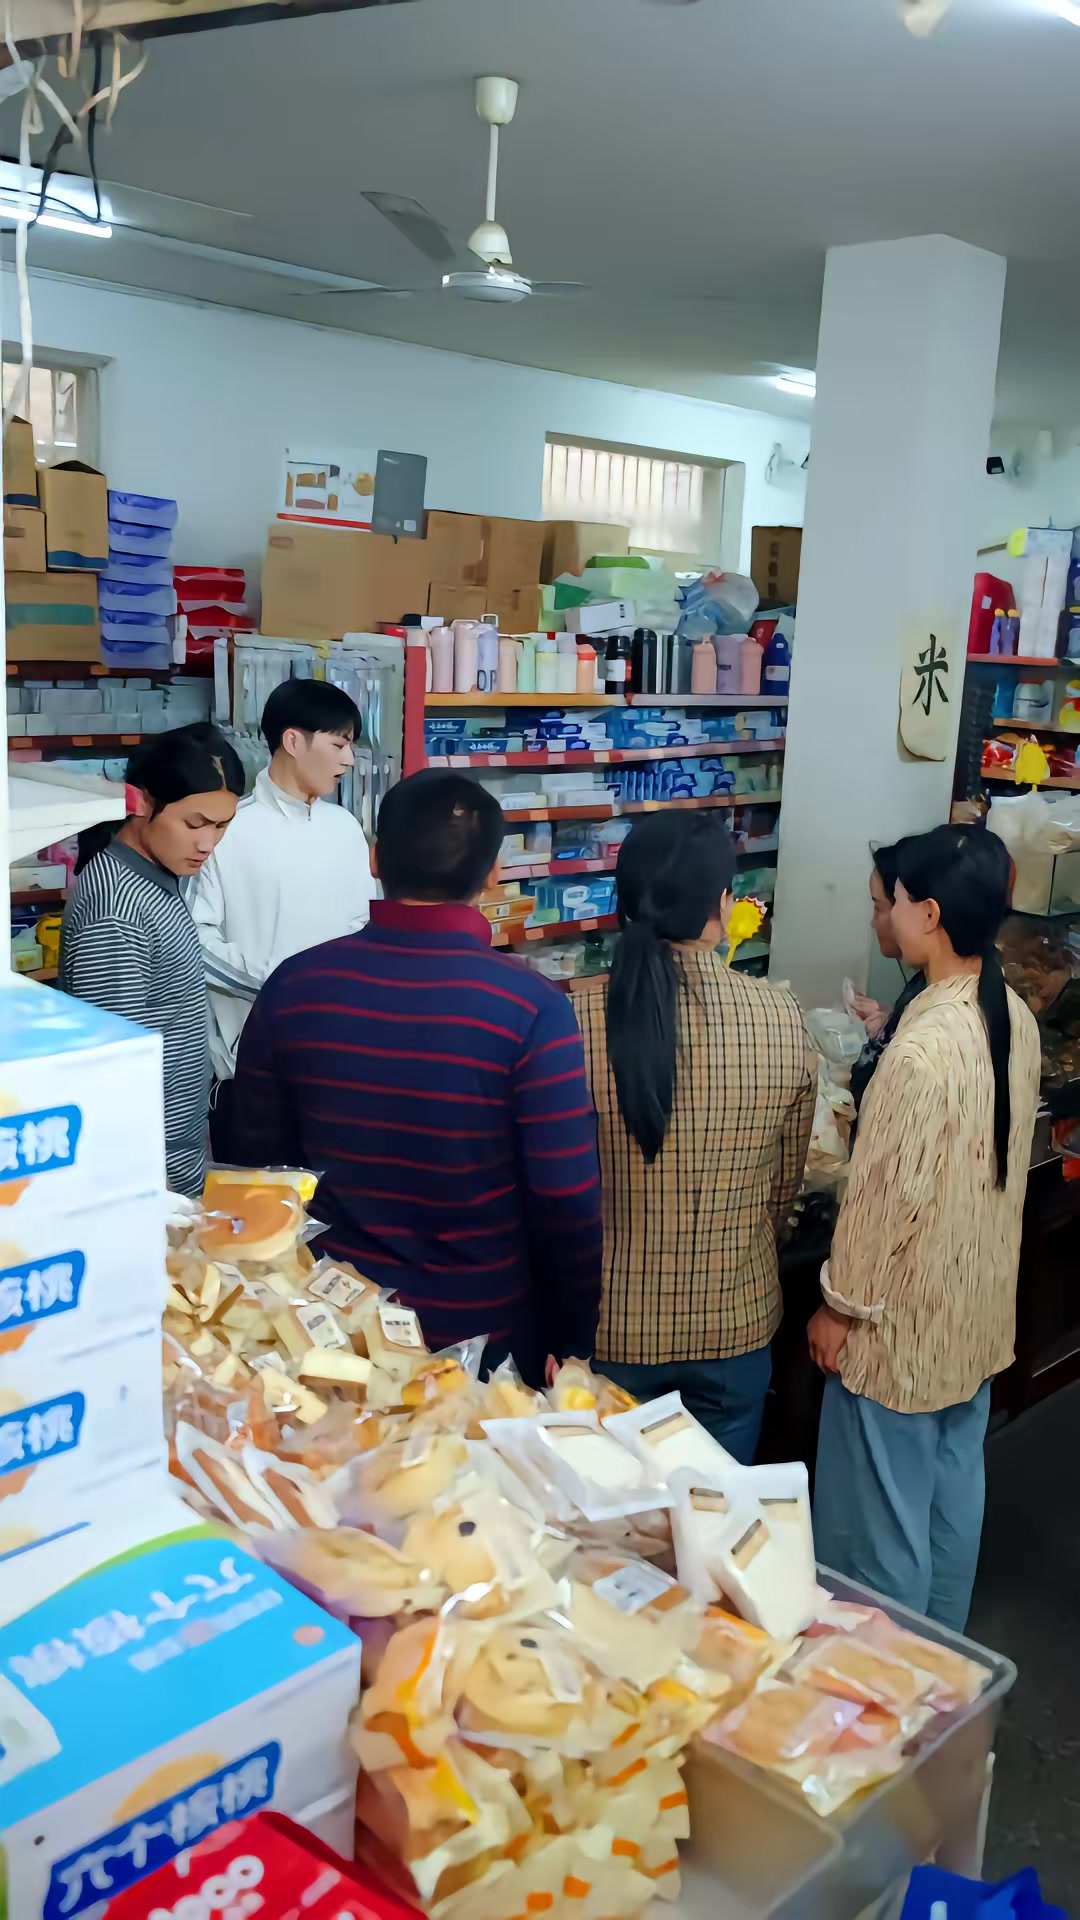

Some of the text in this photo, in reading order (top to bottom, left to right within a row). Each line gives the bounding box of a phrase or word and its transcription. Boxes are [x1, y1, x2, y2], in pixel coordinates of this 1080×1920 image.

[912, 633, 949, 716] 米
[58, 1756, 269, 1912] 六个核桃
